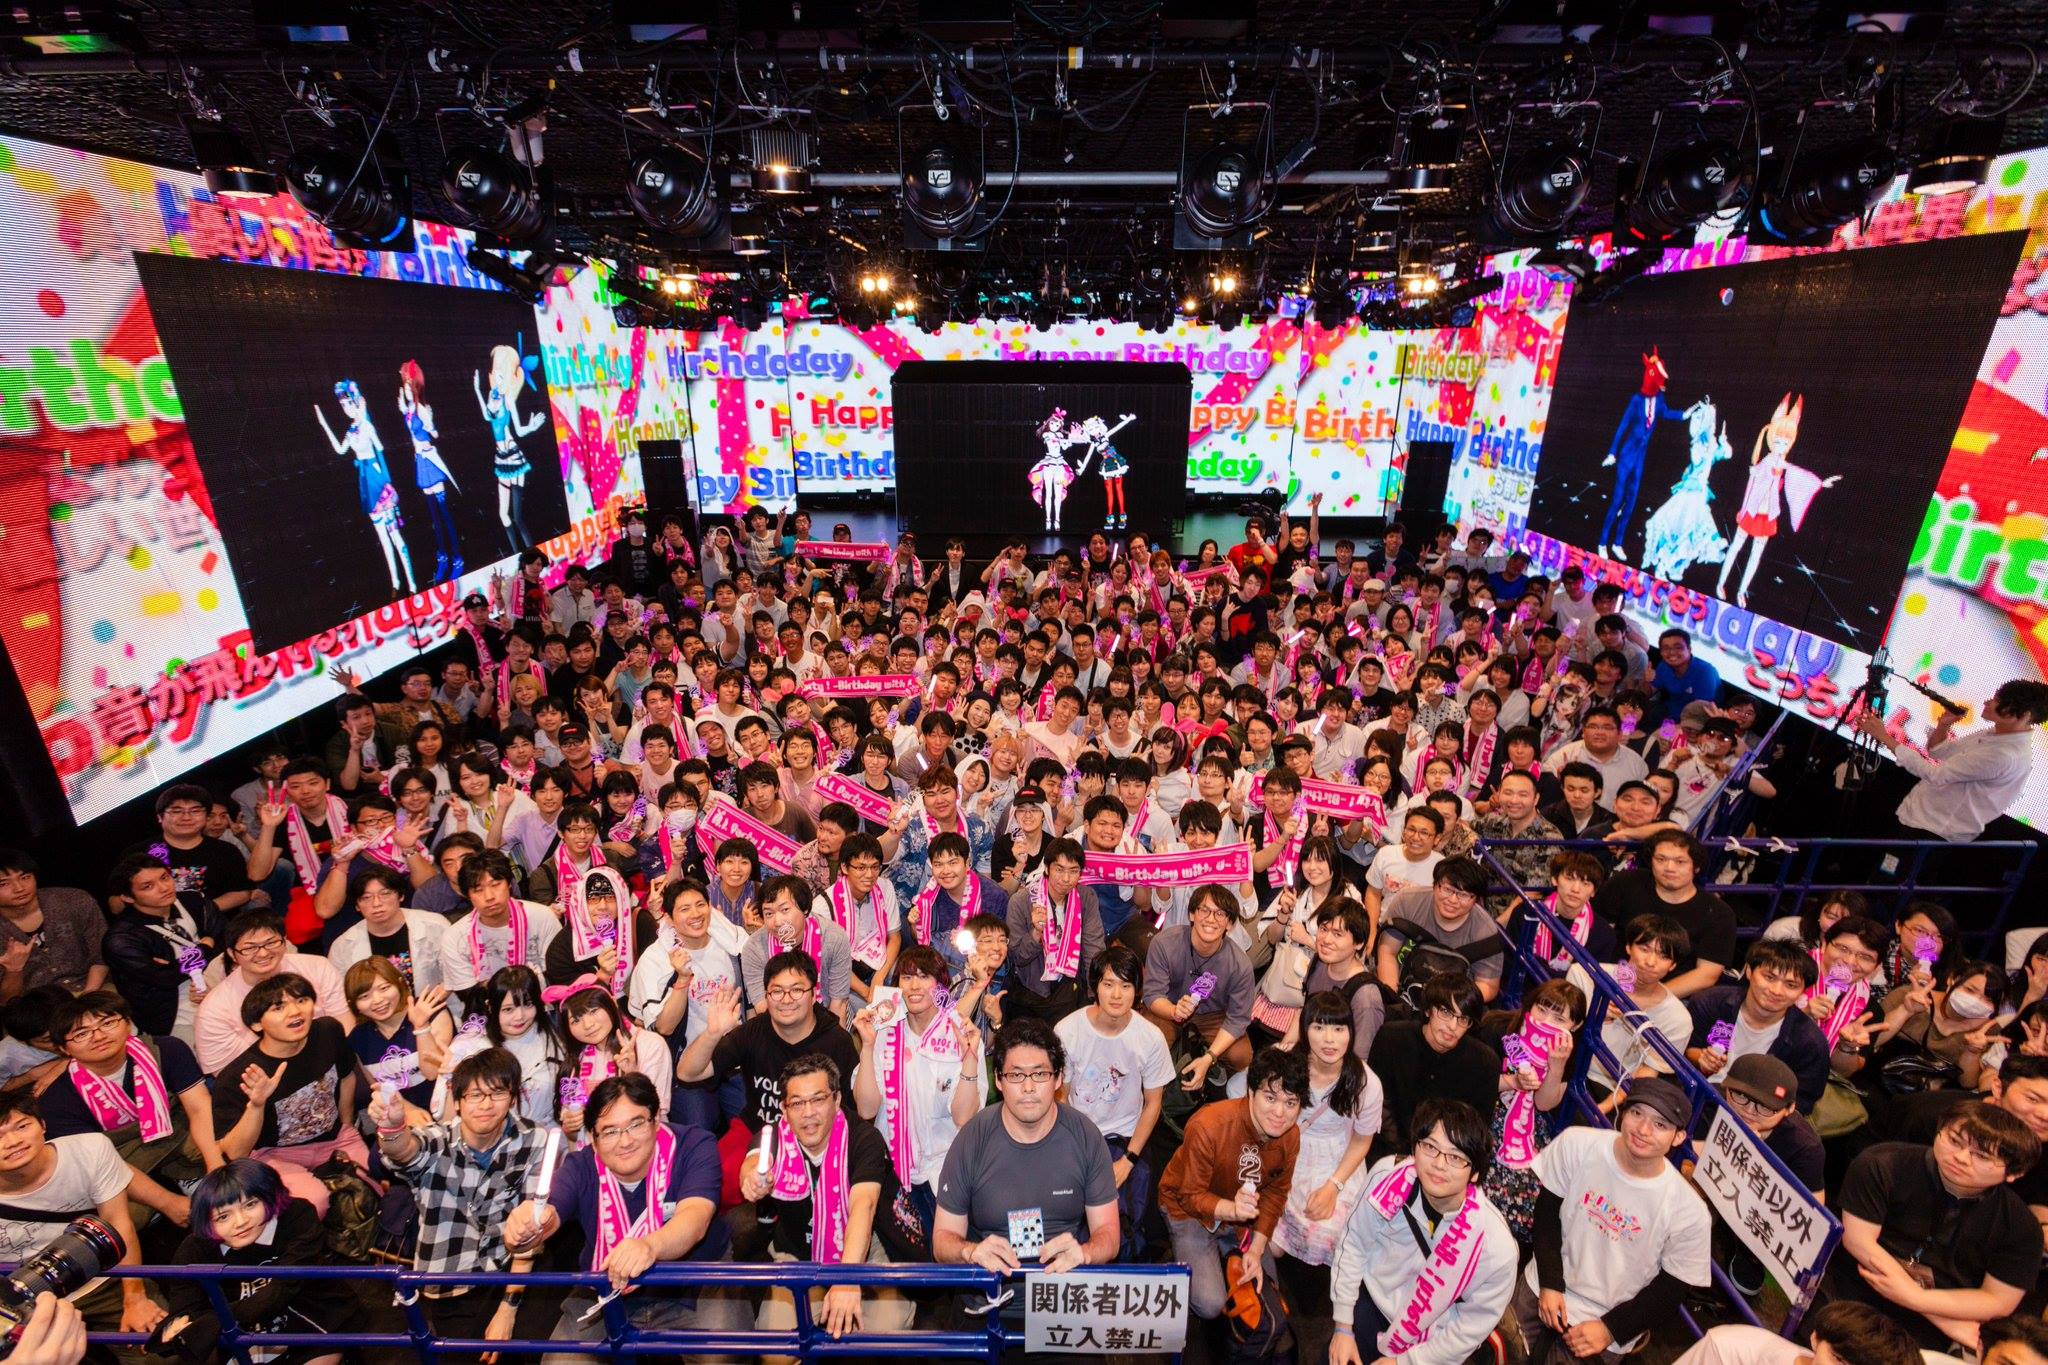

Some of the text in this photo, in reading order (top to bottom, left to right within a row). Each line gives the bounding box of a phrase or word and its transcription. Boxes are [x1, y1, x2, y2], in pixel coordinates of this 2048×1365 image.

[1108, 866, 1180, 882] -Birthday
[1712, 1118, 1812, 1246] 関係者以外
[1702, 1155, 1799, 1281] 立入禁止
[1031, 1282, 1183, 1319] 関係者以外
[1045, 1324, 1162, 1350] 立入禁止
